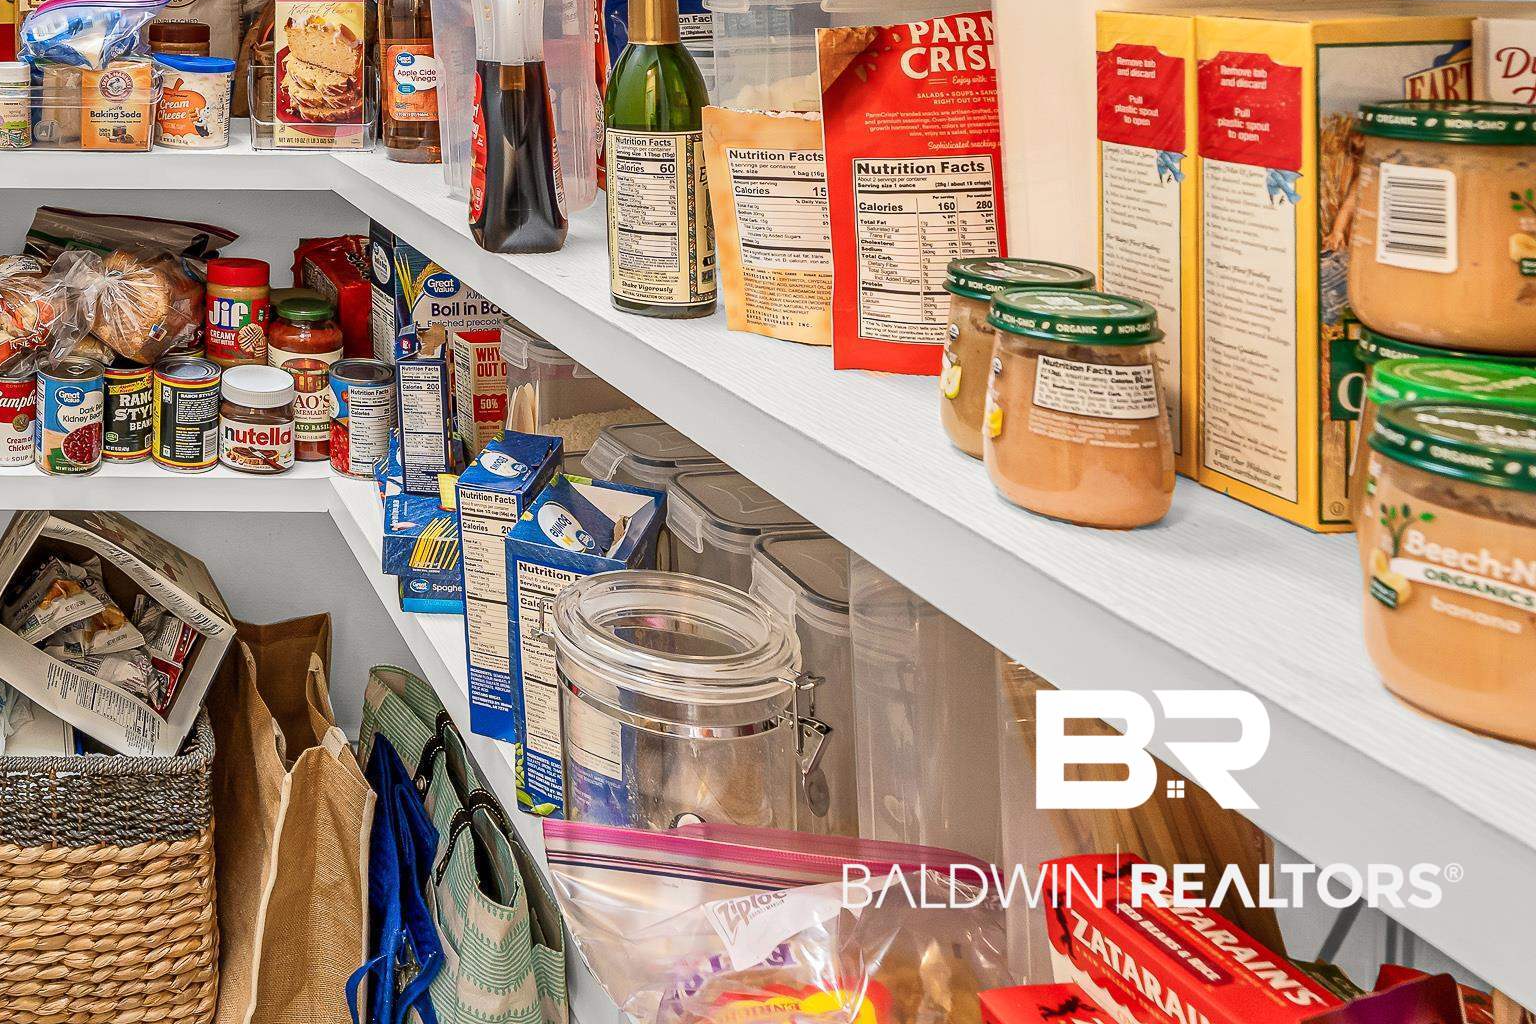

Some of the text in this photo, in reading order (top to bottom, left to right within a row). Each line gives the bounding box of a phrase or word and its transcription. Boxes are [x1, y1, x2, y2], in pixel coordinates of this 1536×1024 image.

[1116, 57, 1143, 67] Remove
[1130, 69, 1156, 78] discard
[1220, 65, 1252, 77] Remove
[952, 76, 972, 85] Enjoy
[1236, 80, 1267, 90] discard
[159, 98, 190, 109] Cream
[1129, 95, 1143, 105] Pull
[90, 110, 142, 120] Baking Soda
[157, 109, 187, 120] Cheese
[1115, 103, 1159, 117] plastic spout
[1234, 107, 1251, 118] Pull
[1132, 117, 1151, 127] open
[1217, 117, 1270, 132] plastic spout
[1238, 131, 1260, 142] open
[616, 138, 672, 147] Nutrition Facts
[928, 139, 969, 150] Sophisticated
[729, 150, 824, 162] Nutrition Facts
[617, 163, 675, 174] Calories 60
[857, 161, 985, 174] Nutrition Facts
[735, 186, 770, 195] Calories
[859, 201, 993, 212] Calories 160 280
[427, 278, 455, 288] Great
[622, 281, 673, 293] Shake Vigorously
[209, 299, 249, 327] Jif
[431, 302, 477, 316] Boil in
[428, 320, 464, 328] Enriched
[1056, 324, 1098, 335] ORGANIC
[210, 329, 236, 340] CREAMY
[476, 348, 500, 362] WHY
[477, 362, 498, 377] OUT
[1043, 358, 1113, 376] Nutrition Facts
[58, 390, 81, 400] Great
[351, 388, 374, 396] Nutrition
[294, 394, 330, 409] AO'S
[480, 399, 498, 410] 50%
[79, 406, 94, 416] Dark
[63, 414, 88, 424] Kidney
[7, 437, 26, 445] Cream
[225, 427, 292, 445] nutella
[9, 443, 32, 452] Chicken
[1430, 445, 1494, 471] ORGANIC
[460, 490, 516, 505] Nutrition Facts
[462, 522, 488, 532] Calories
[1404, 528, 1536, 587] Beech-N
[519, 562, 571, 582] Nutrition
[519, 579, 542, 589] Serving
[717, 890, 788, 946] Ziploc
[1070, 909, 1212, 1024] ZATARAI
